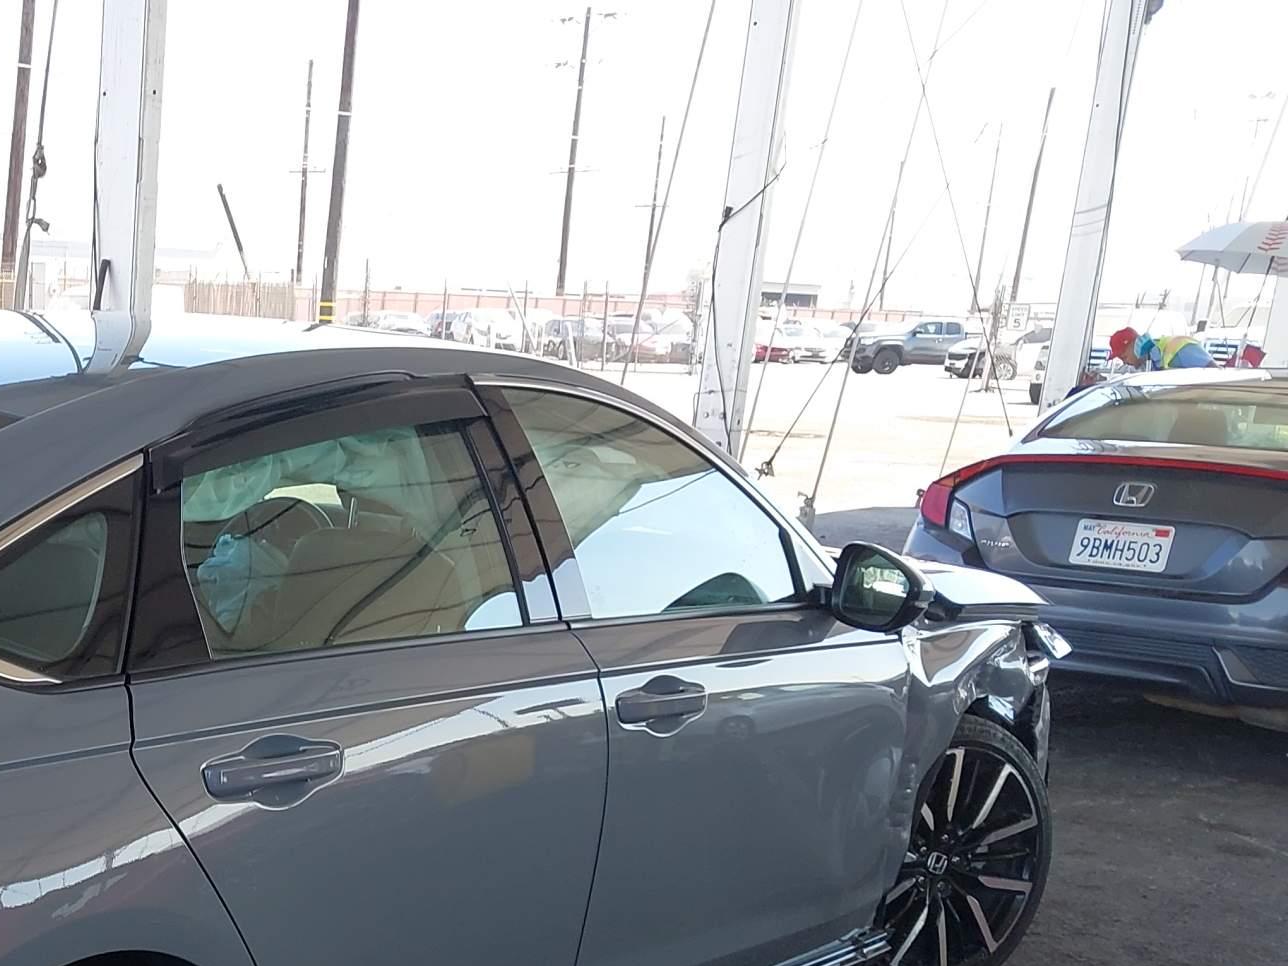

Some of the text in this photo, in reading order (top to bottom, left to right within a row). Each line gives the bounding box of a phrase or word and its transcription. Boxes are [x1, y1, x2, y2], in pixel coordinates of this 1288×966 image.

[1013, 318, 1022, 328] 5
[1096, 525, 1152, 539] California
[1076, 536, 1163, 564] 9BMH503
